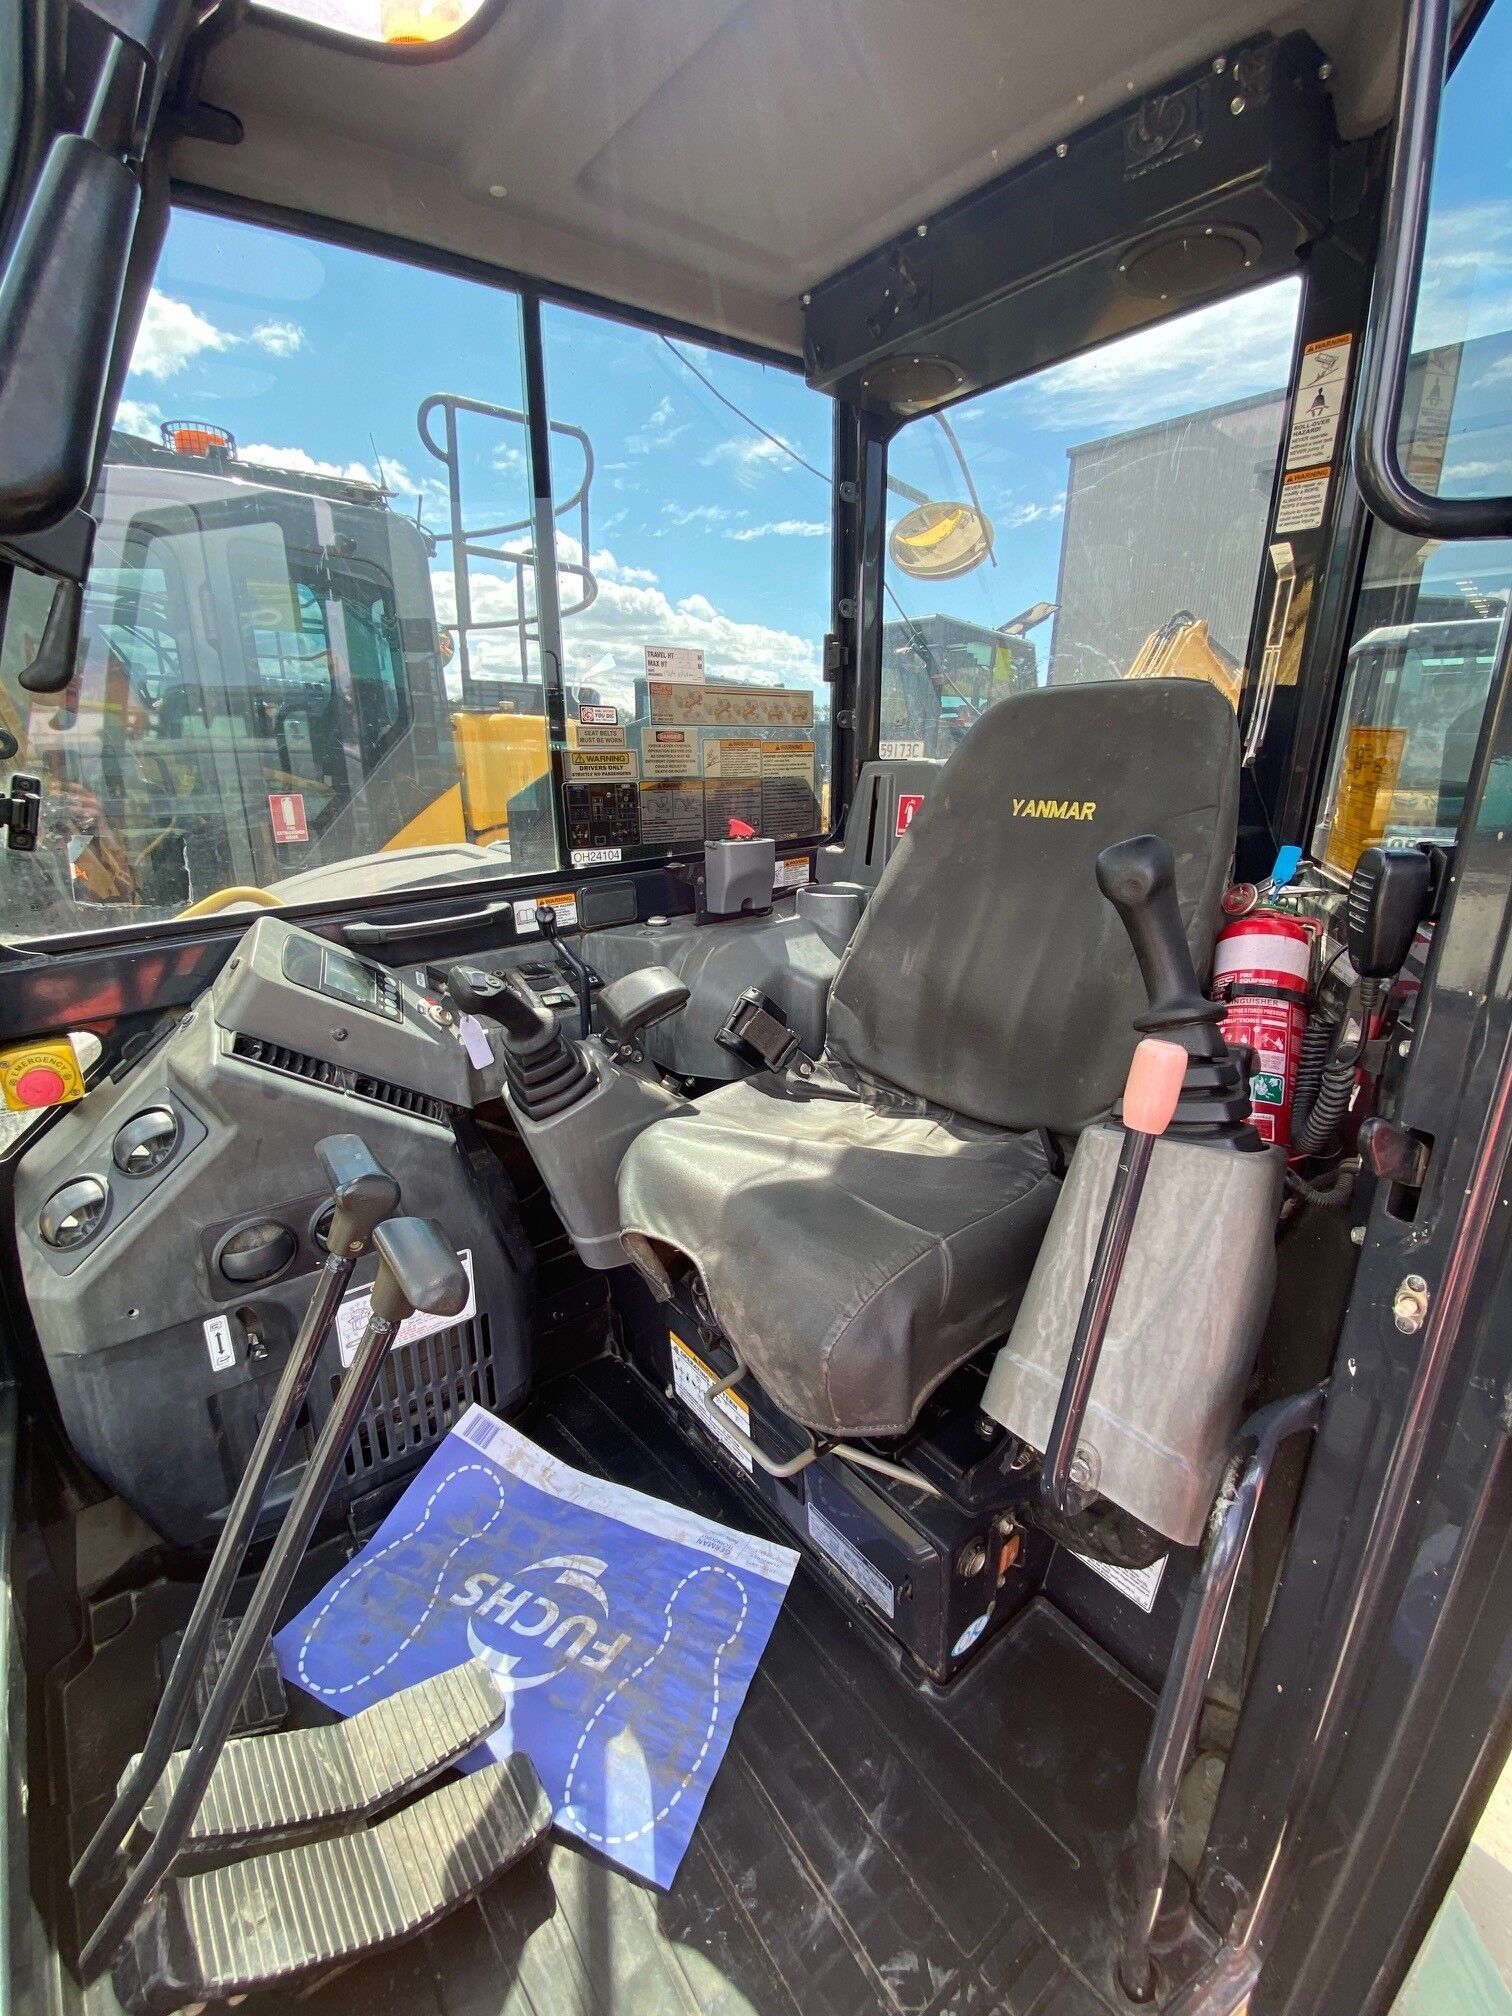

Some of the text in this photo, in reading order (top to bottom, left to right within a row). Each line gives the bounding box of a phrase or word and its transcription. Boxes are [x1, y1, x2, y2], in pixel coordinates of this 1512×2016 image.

[1315, 335, 1350, 350] WARNING
[1294, 419, 1330, 431] ROLL-OVER
[1295, 469, 1328, 481] WARNING
[1012, 798, 1097, 821] YANMAR
[573, 850, 620, 863] OH24104
[545, 895, 572, 904] WARNING
[1239, 977, 1279, 985] EQUIPMENT
[11, 1056, 68, 1077] EMERGENCY
[696, 1538, 731, 1556] GERMAN
[450, 1573, 632, 1674] FUCHS
